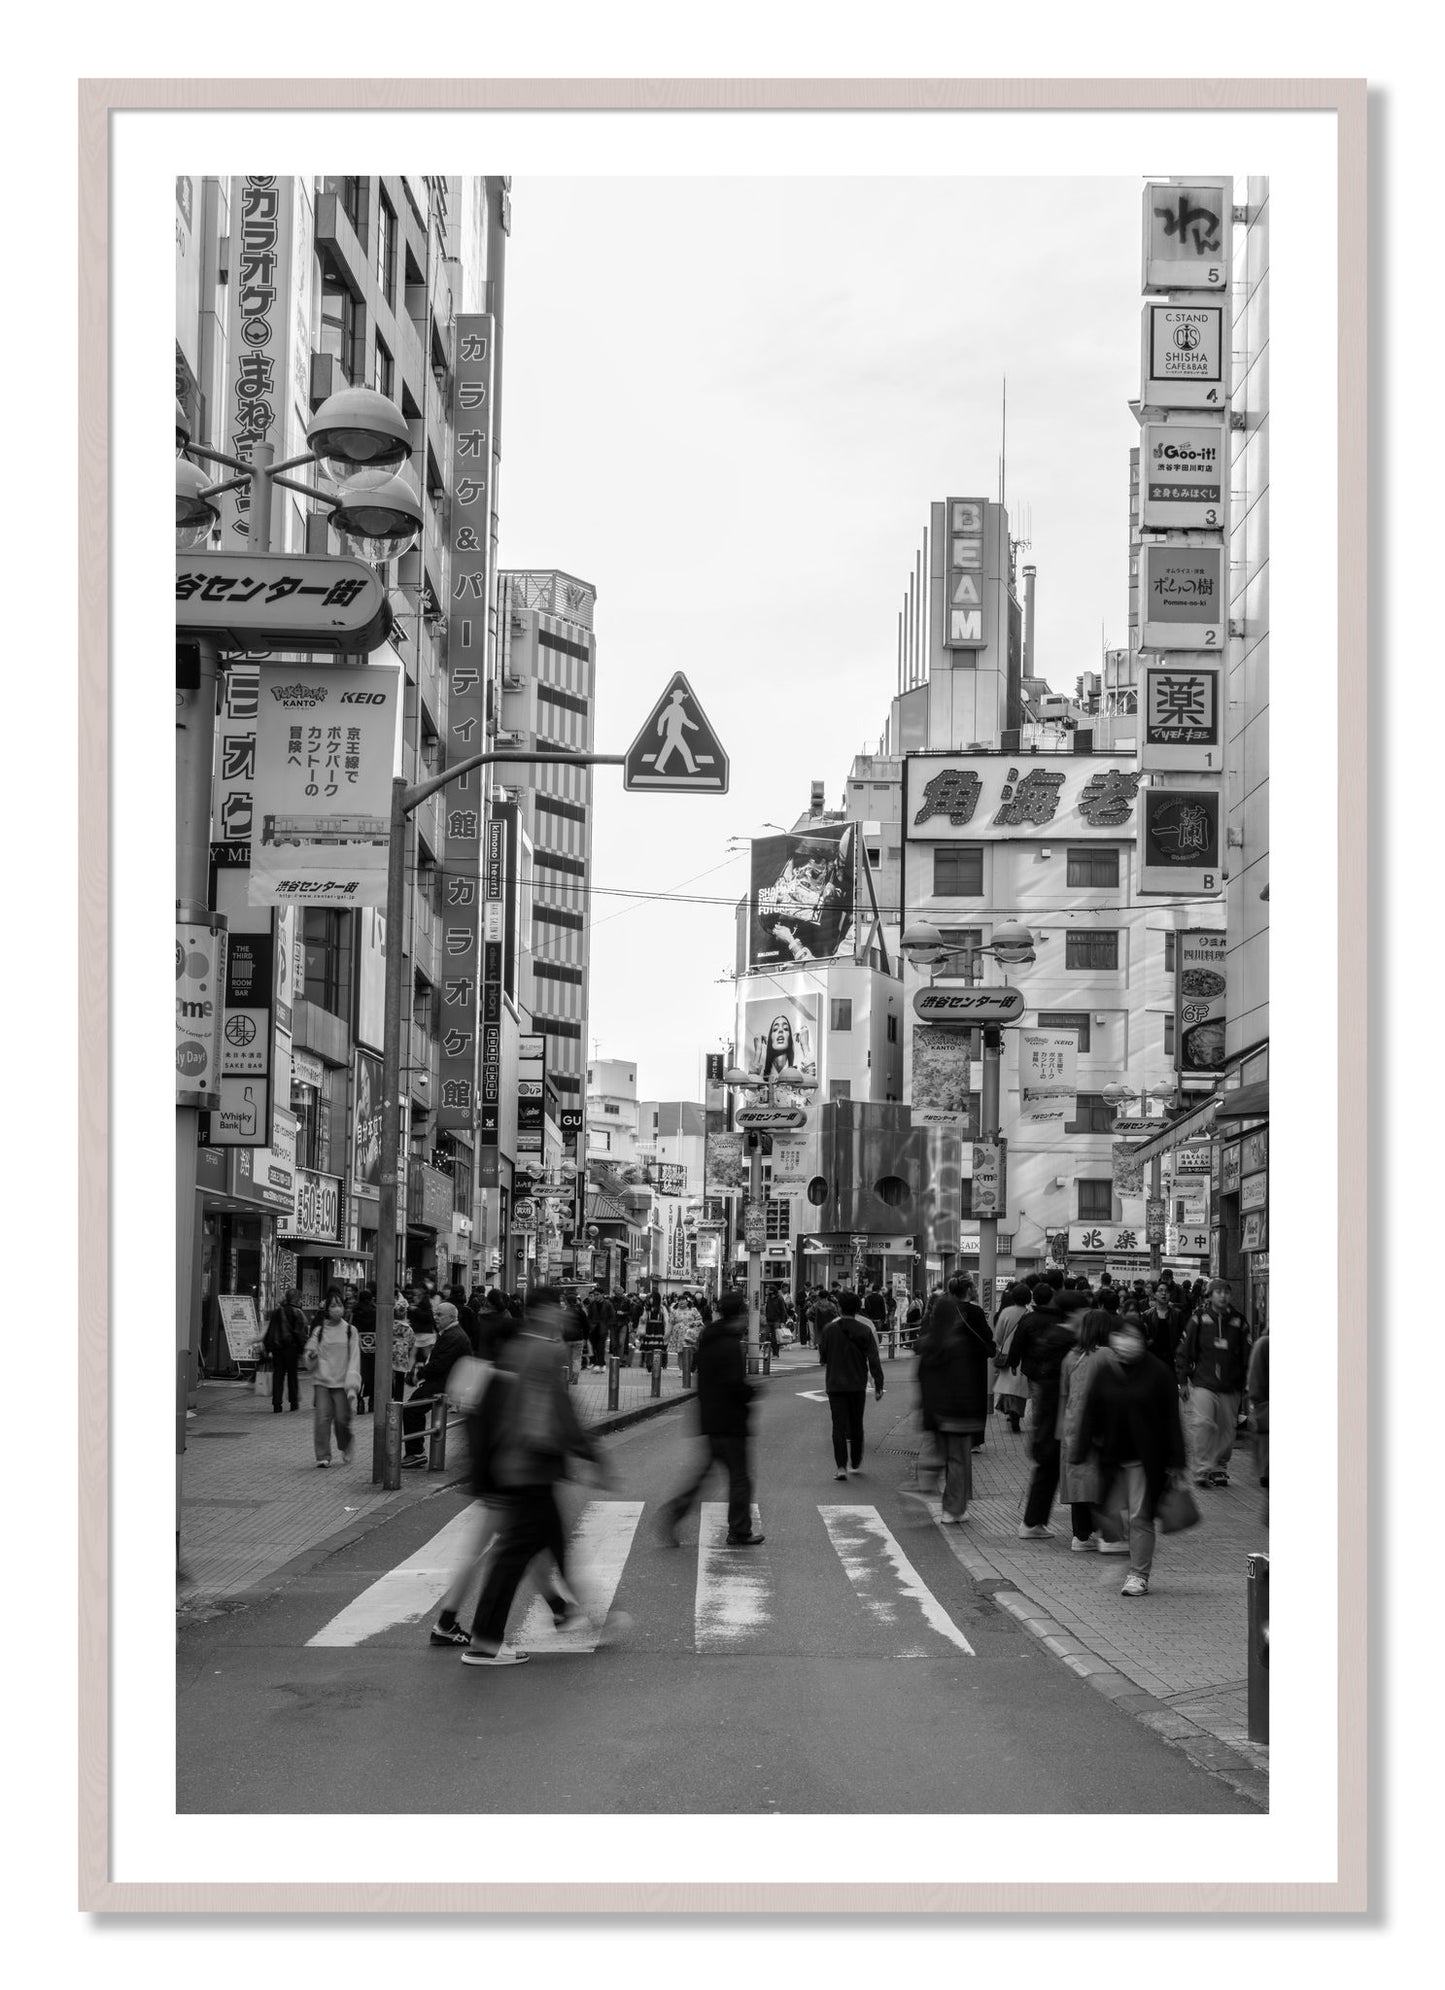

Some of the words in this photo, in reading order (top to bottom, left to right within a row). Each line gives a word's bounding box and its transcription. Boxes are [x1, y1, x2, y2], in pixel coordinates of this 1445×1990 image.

[238, 187, 279, 319] カラオケ
[1208, 268, 1220, 284] 5
[1165, 313, 1209, 323] C.STAND
[1165, 352, 1208, 362] SHISHA
[1165, 362, 1208, 371] CAFE&BAR
[1206, 388, 1218, 403] 4
[1164, 445, 1216, 460] Goo-it!
[1157, 463, 1213, 473] 渋谷宇田川町店
[1152, 487, 1217, 499] 全身もみほぐし
[1205, 509, 1217, 525] 3
[951, 503, 982, 641] BEAM
[1205, 630, 1217, 645] 2
[340, 692, 387, 705] KEIO
[1156, 676, 1205, 725] 薬
[287, 726, 303, 767] 冒険へ
[304, 726, 322, 797] カントーの
[323, 726, 342, 797] ポケパーク
[344, 727, 361, 784] 京王線で
[1204, 752, 1212, 767] 1
[914, 767, 1142, 826] 角海老
[491, 825, 500, 859] kimono
[274, 880, 361, 893] 渋谷センター街
[490, 863, 499, 897] hearts
[1203, 875, 1215, 889] B
[232, 952, 253, 960] THIRD
[920, 996, 1018, 1009] 渋谷センター街
[1183, 1004, 1209, 1023] 6F
[220, 1112, 252, 1122] Whisky
[562, 1115, 582, 1126] GU
[220, 1120, 239, 1130] Bank
[1081, 1229, 1138, 1250] 兆楽
[674, 1227, 684, 1268] BEER
